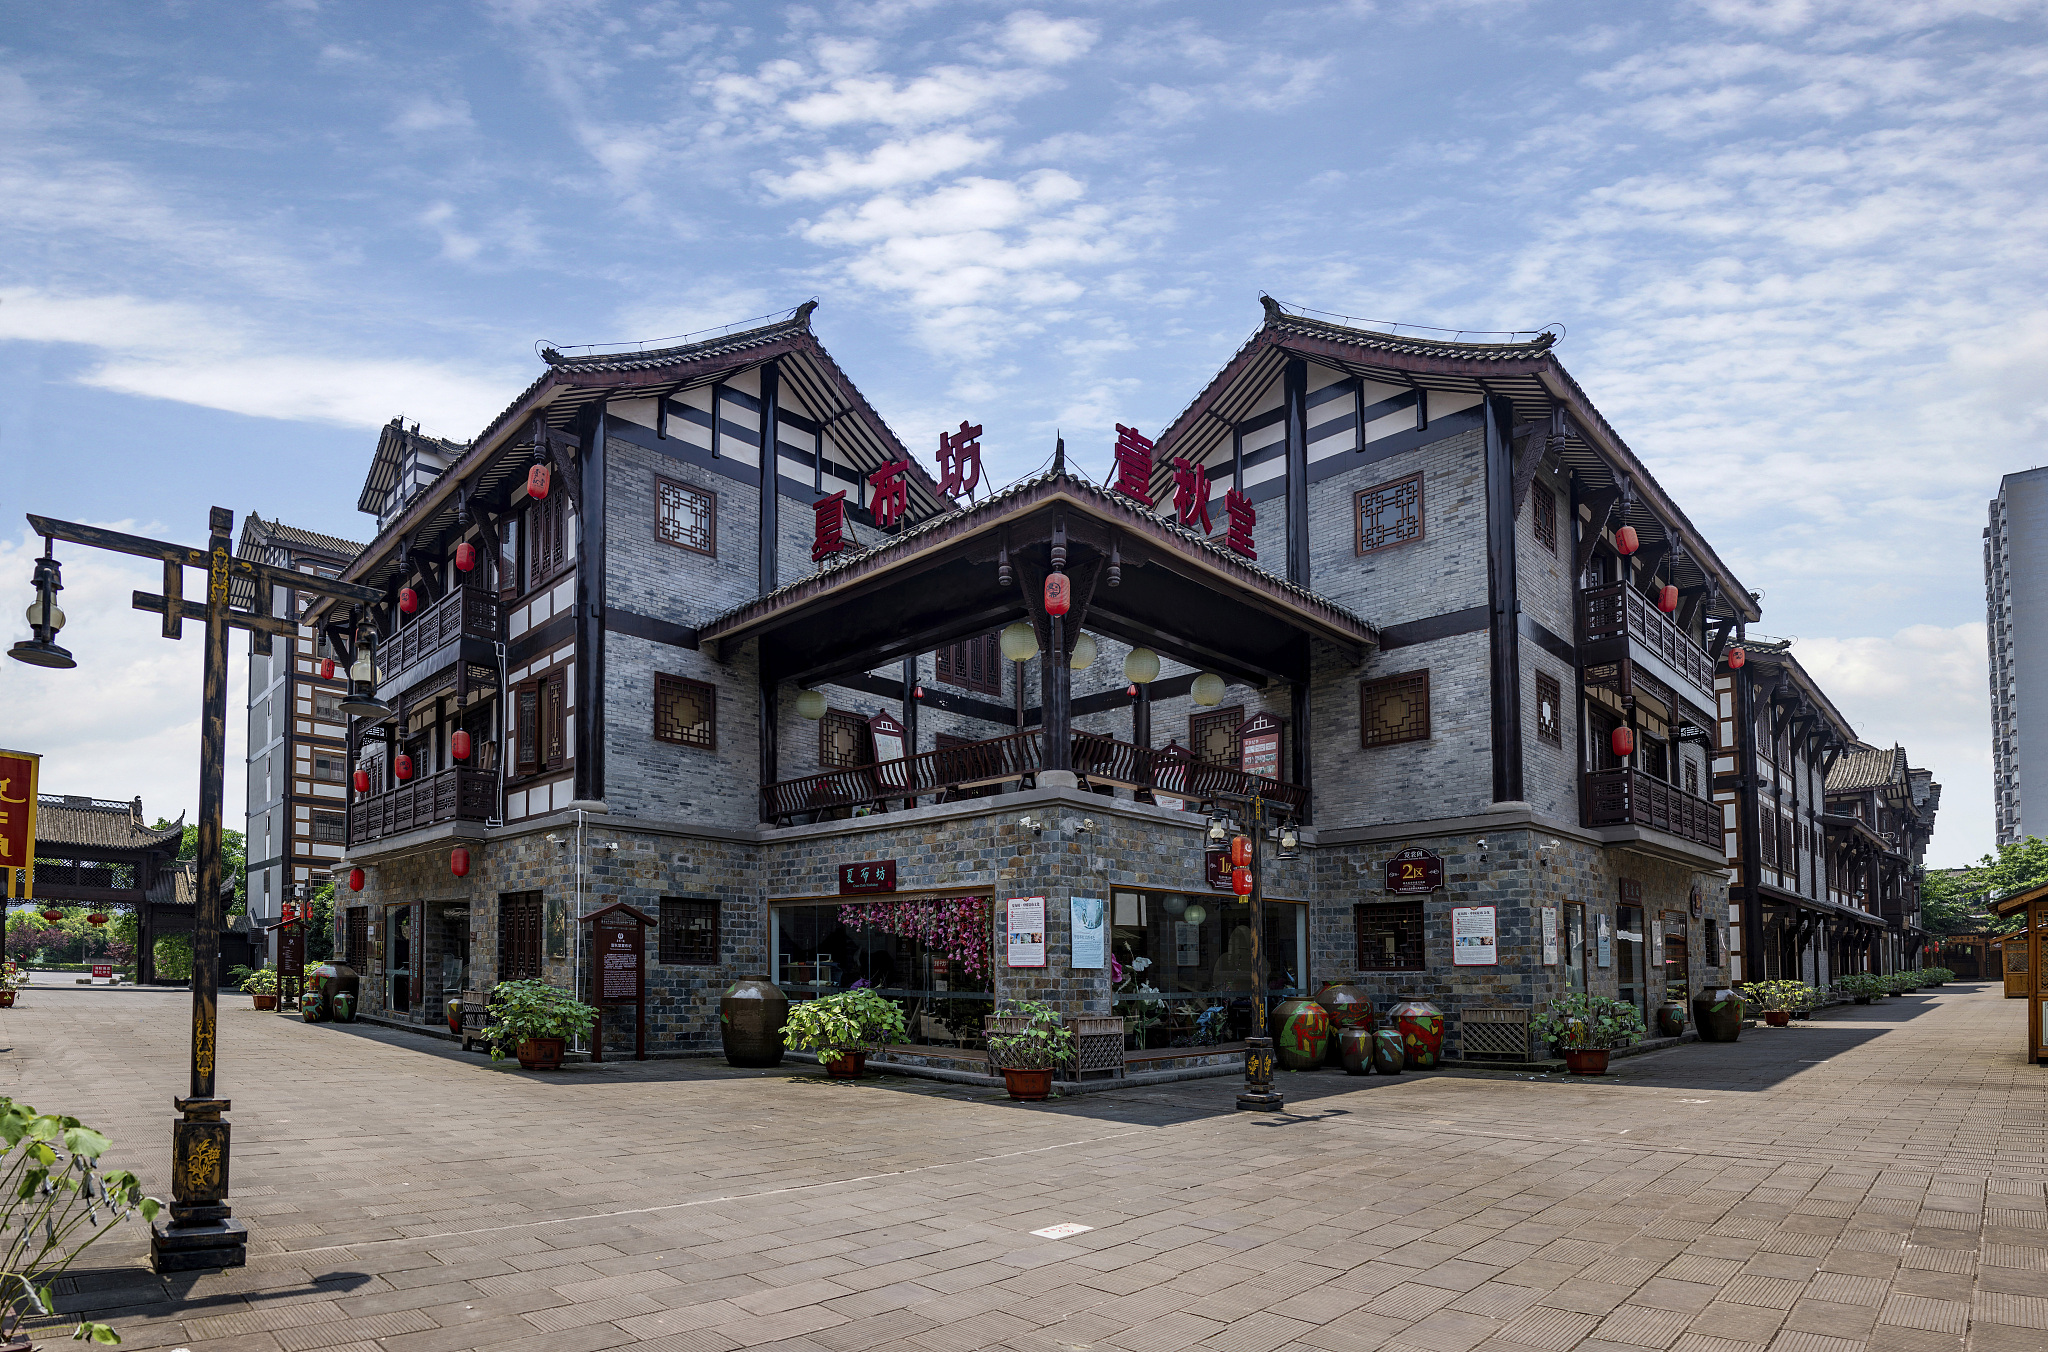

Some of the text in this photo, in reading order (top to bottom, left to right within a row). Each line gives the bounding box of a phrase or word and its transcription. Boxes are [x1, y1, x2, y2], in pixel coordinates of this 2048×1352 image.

[811, 419, 983, 562] 夏布坊
[1113, 422, 1258, 561] 壹秋堂
[846, 866, 886, 884] 夏布坊
[1402, 863, 1424, 879] 2区
